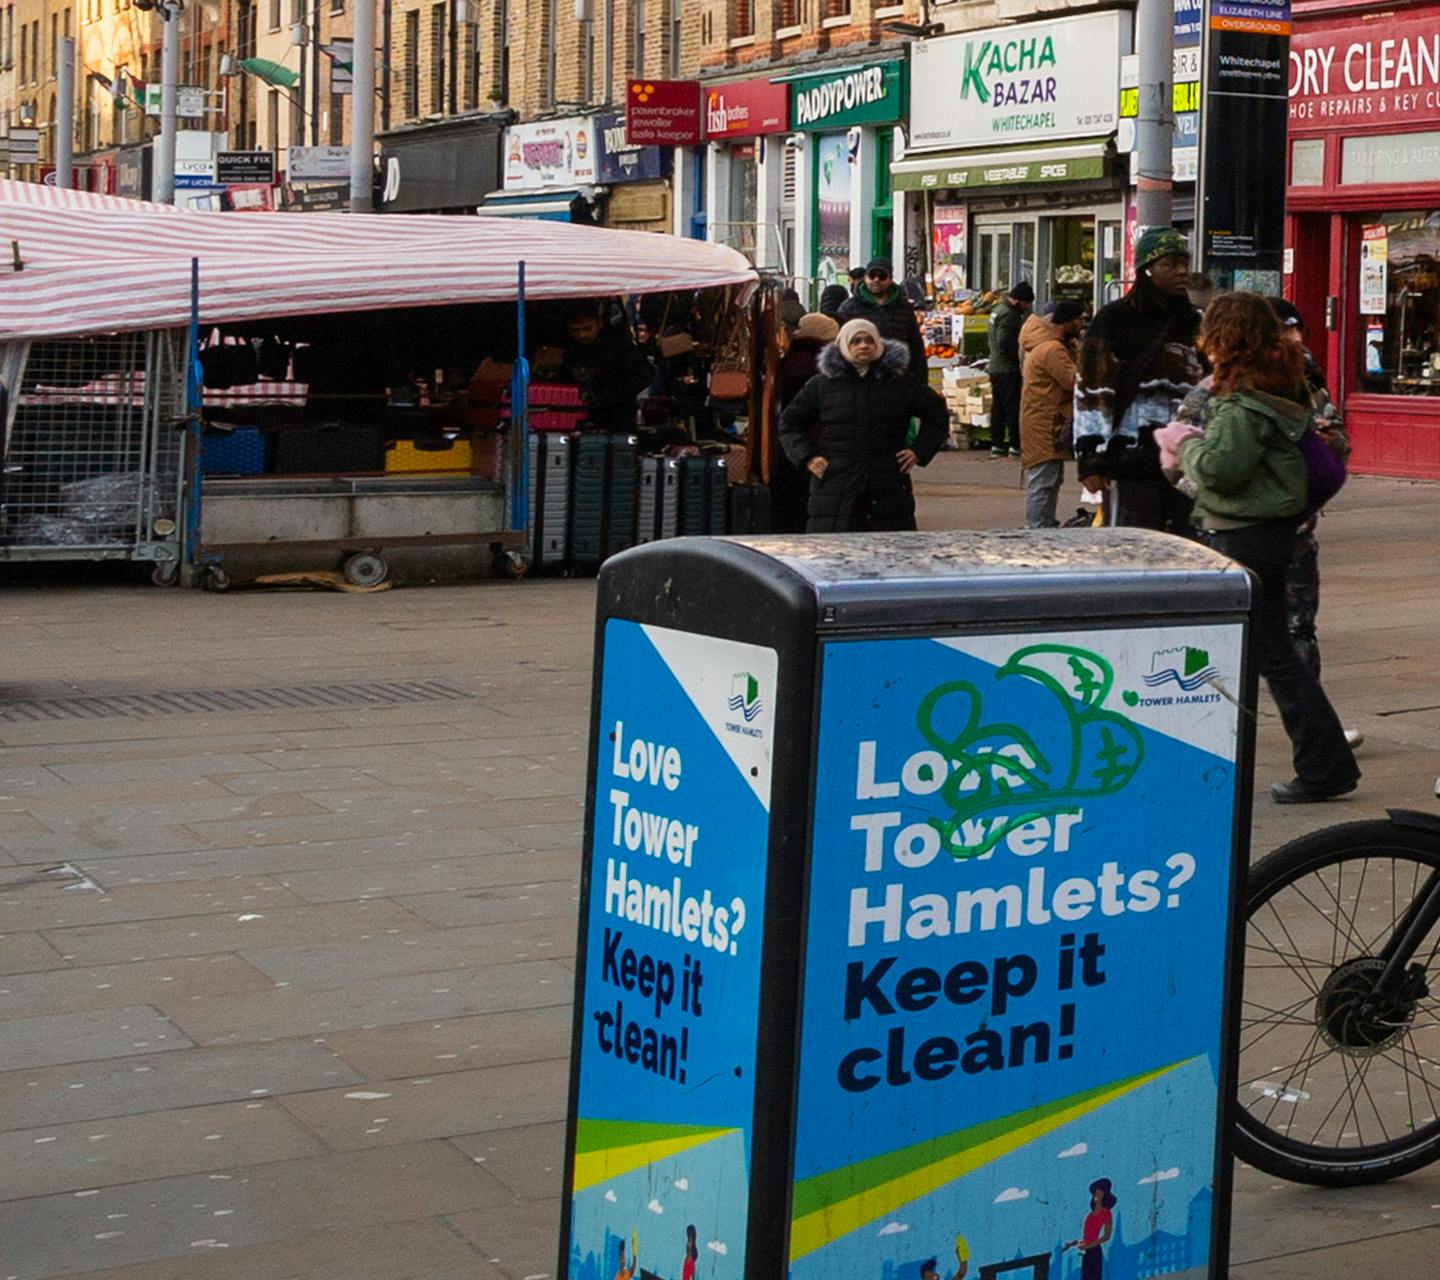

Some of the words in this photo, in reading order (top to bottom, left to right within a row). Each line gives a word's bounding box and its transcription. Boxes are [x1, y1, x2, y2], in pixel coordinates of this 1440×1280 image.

[1219, 6, 1264, 17] ELIZABETH
[1265, 10, 1283, 19] LINE
[1221, 18, 1281, 32] OVERGROUND
[960, 36, 1056, 103] KACHA
[1219, 54, 1281, 70] Whitechapel
[1288, 46, 1335, 97] DRY
[993, 76, 1056, 107] BAZAR
[1320, 96, 1372, 115] REPAIRS
[1379, 96, 1387, 112] &
[1394, 92, 1418, 110] KEY
[631, 106, 696, 119] pawnbroker
[632, 118, 673, 131] jeweller
[706, 92, 728, 134] fish
[992, 111, 1056, 132] WHITECHAPEL
[631, 130, 655, 140] safe
[657, 130, 694, 143] keeper
[217, 154, 251, 165] QUICK
[254, 154, 271, 164] FIX
[947, 171, 968, 184] MEAT
[983, 166, 1028, 181] VEGETABLES
[1039, 163, 1067, 177] SPICES
[1351, 147, 1400, 165] TAILORING
[1139, 696, 1174, 707] TOWER
[1175, 693, 1221, 704] HAMLETS
[612, 720, 682, 792] Love
[855, 740, 1036, 801] Love
[608, 789, 699, 868] Tower
[850, 807, 1083, 873] Tower
[604, 857, 746, 957] Hamlets?
[847, 851, 1197, 948] Hamlets?
[601, 926, 675, 1019] Keep
[682, 953, 704, 1018] it
[843, 951, 1039, 1021] Keep
[1056, 931, 1107, 992] it
[593, 1000, 689, 1085] clean!
[836, 1002, 1076, 1095] clean!
